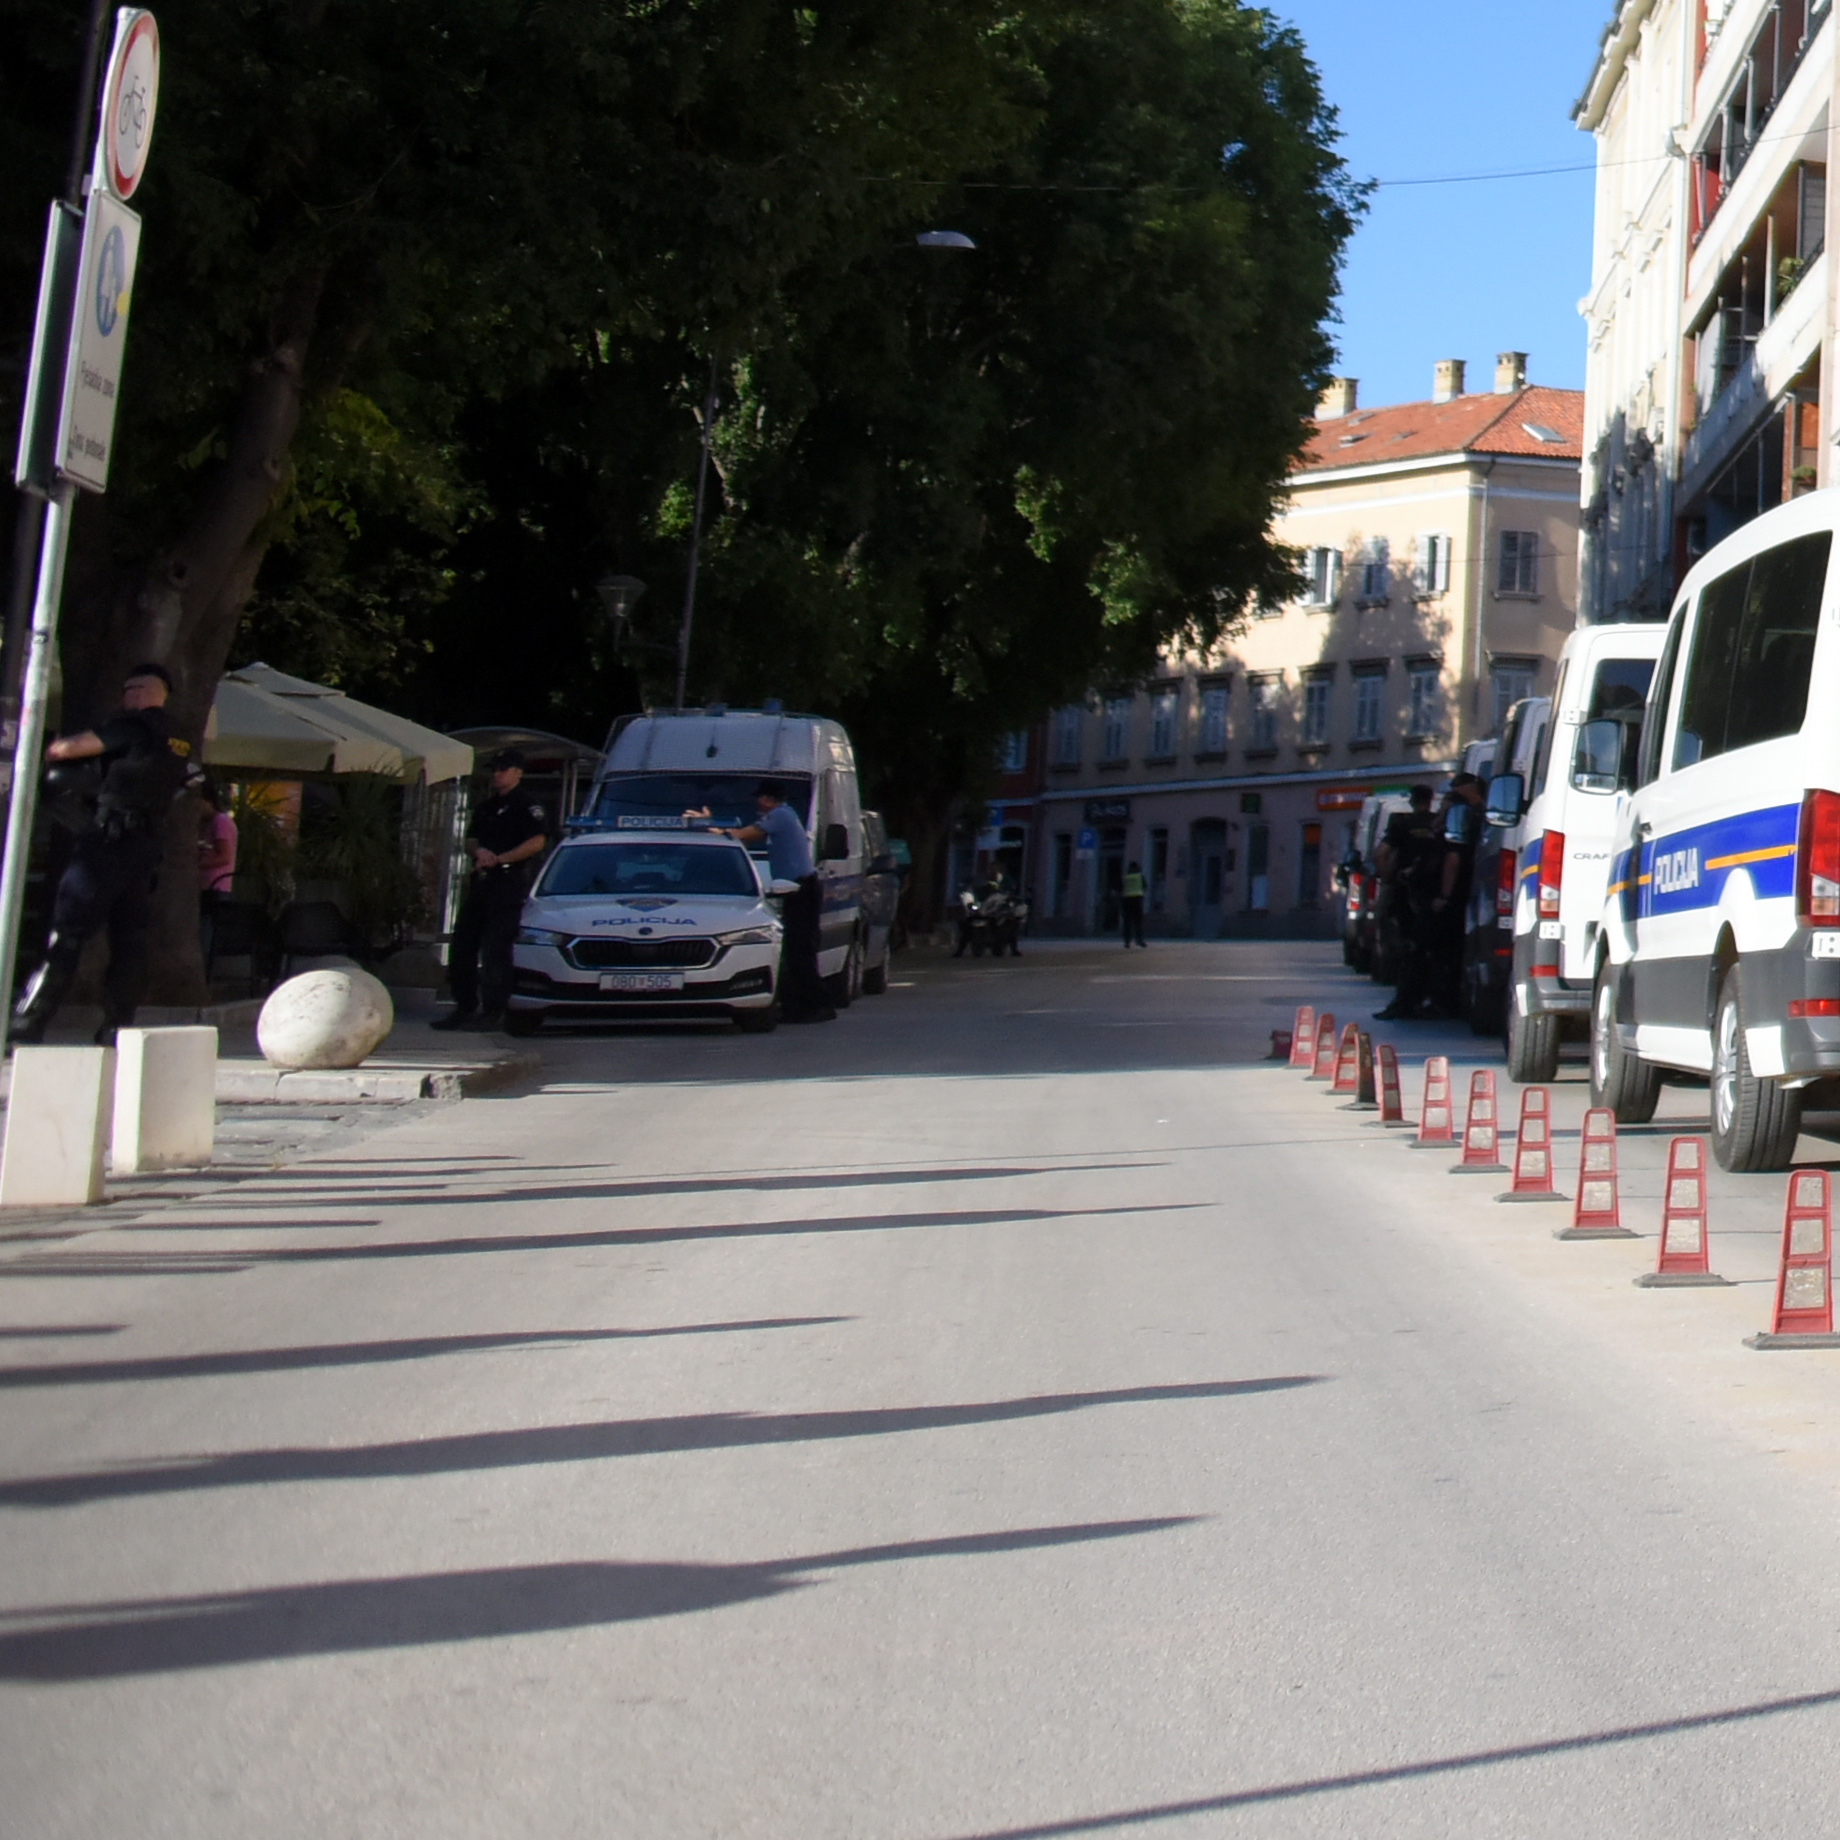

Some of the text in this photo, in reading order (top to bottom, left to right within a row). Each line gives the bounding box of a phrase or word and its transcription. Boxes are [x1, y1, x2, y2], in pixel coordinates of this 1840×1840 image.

[621, 816, 685, 828] POLICIJA
[1573, 852, 1611, 861] CRAF
[1653, 847, 1699, 895] POLICIJA
[592, 917, 698, 927] POLICIJA
